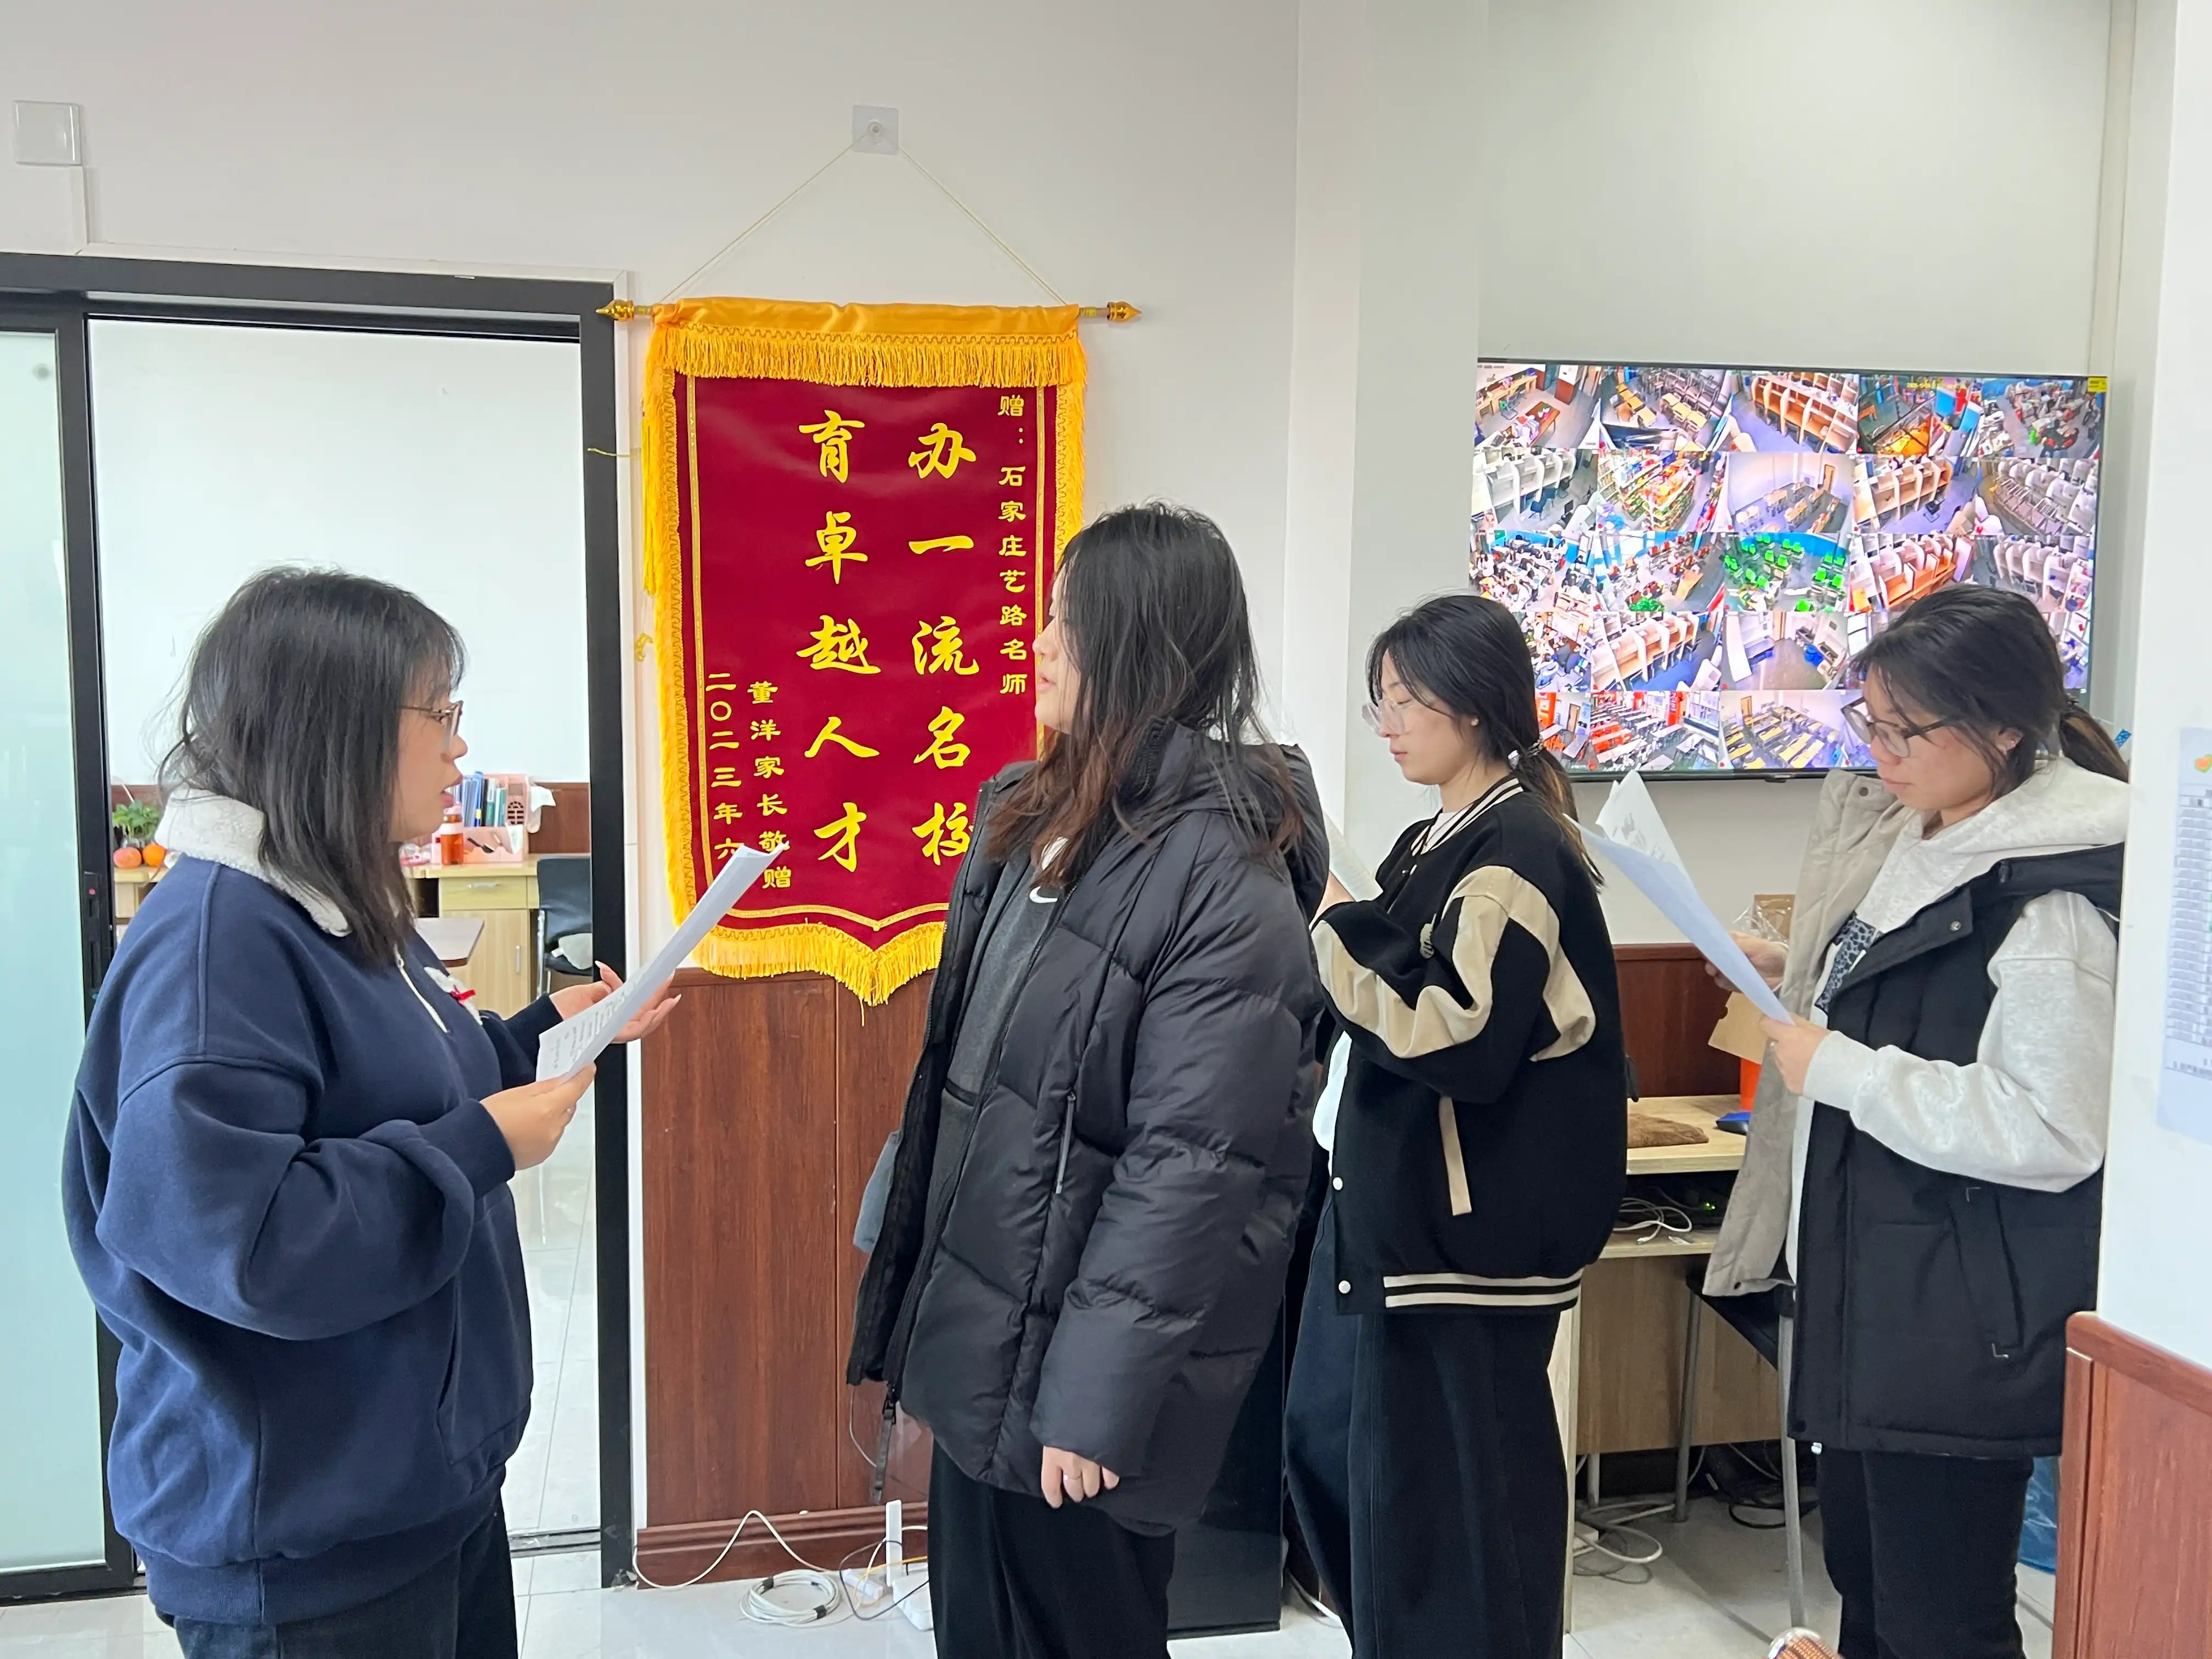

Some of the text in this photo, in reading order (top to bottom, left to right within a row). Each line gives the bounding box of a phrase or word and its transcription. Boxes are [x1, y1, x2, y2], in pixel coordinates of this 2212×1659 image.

[797, 410, 881, 872] 育卓越人才
[908, 422, 979, 866] 办一流名校
[998, 395, 1028, 695] 赠：石家庄艺路名师
[747, 681, 792, 889] 董洋家长敬赠
